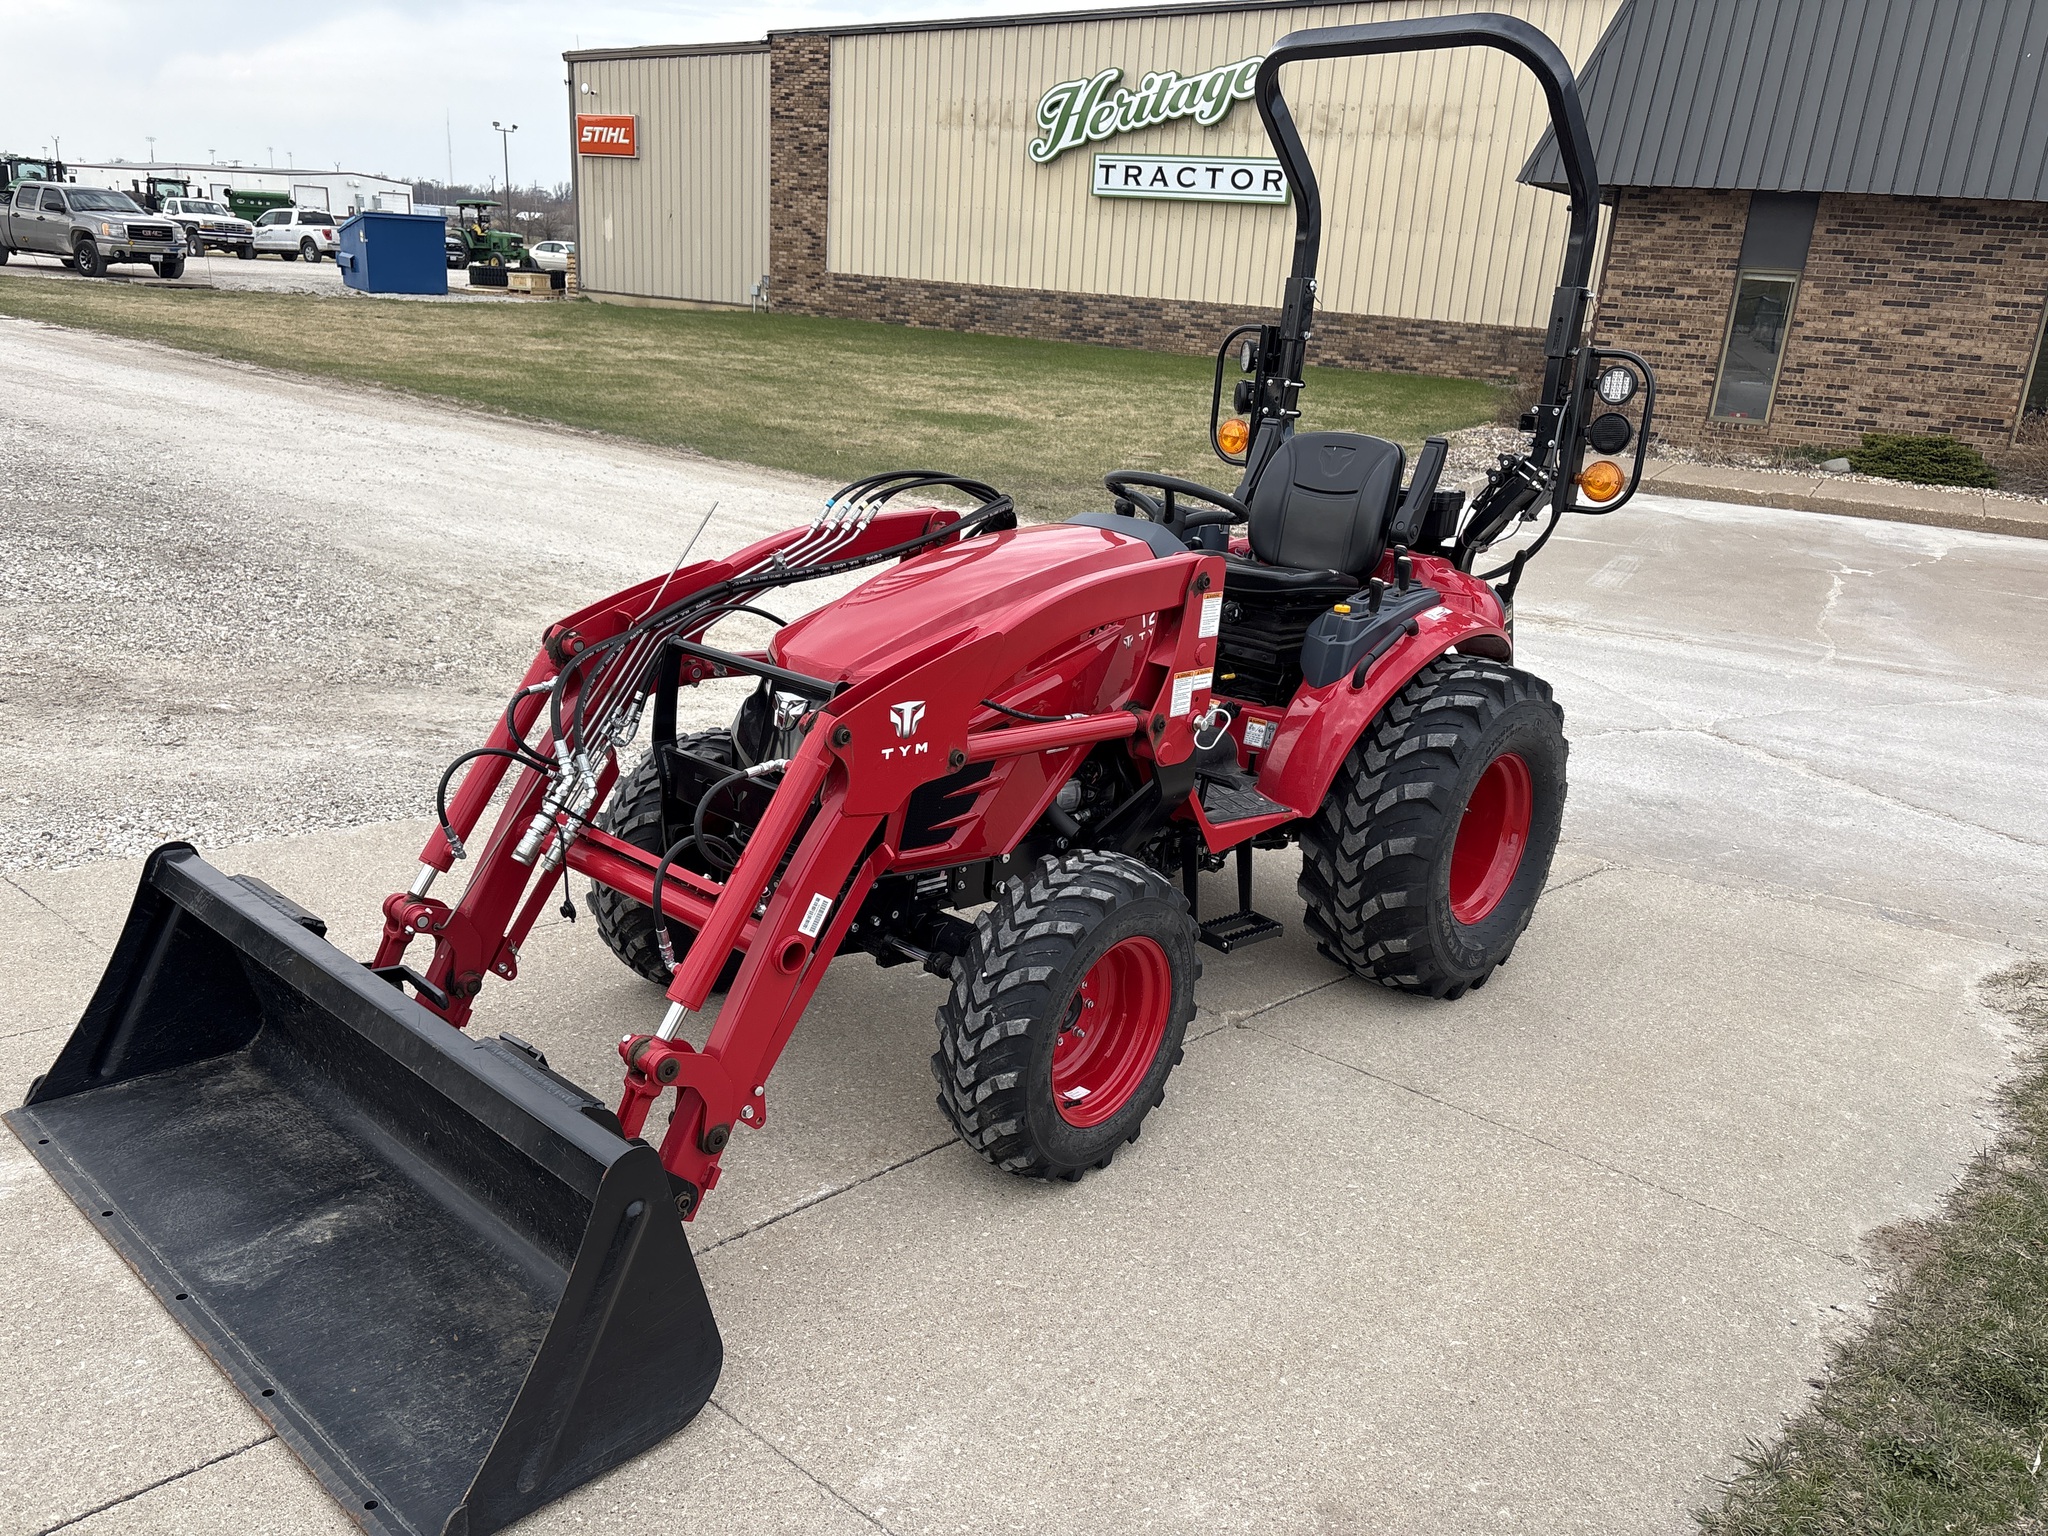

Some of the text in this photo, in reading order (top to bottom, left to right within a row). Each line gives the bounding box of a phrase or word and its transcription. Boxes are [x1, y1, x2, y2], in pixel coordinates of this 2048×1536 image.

[1032, 60, 1262, 157] Heritage
[581, 126, 630, 144] STIHL
[1099, 163, 1284, 192] TRACTOR
[881, 741, 929, 760] TYM
